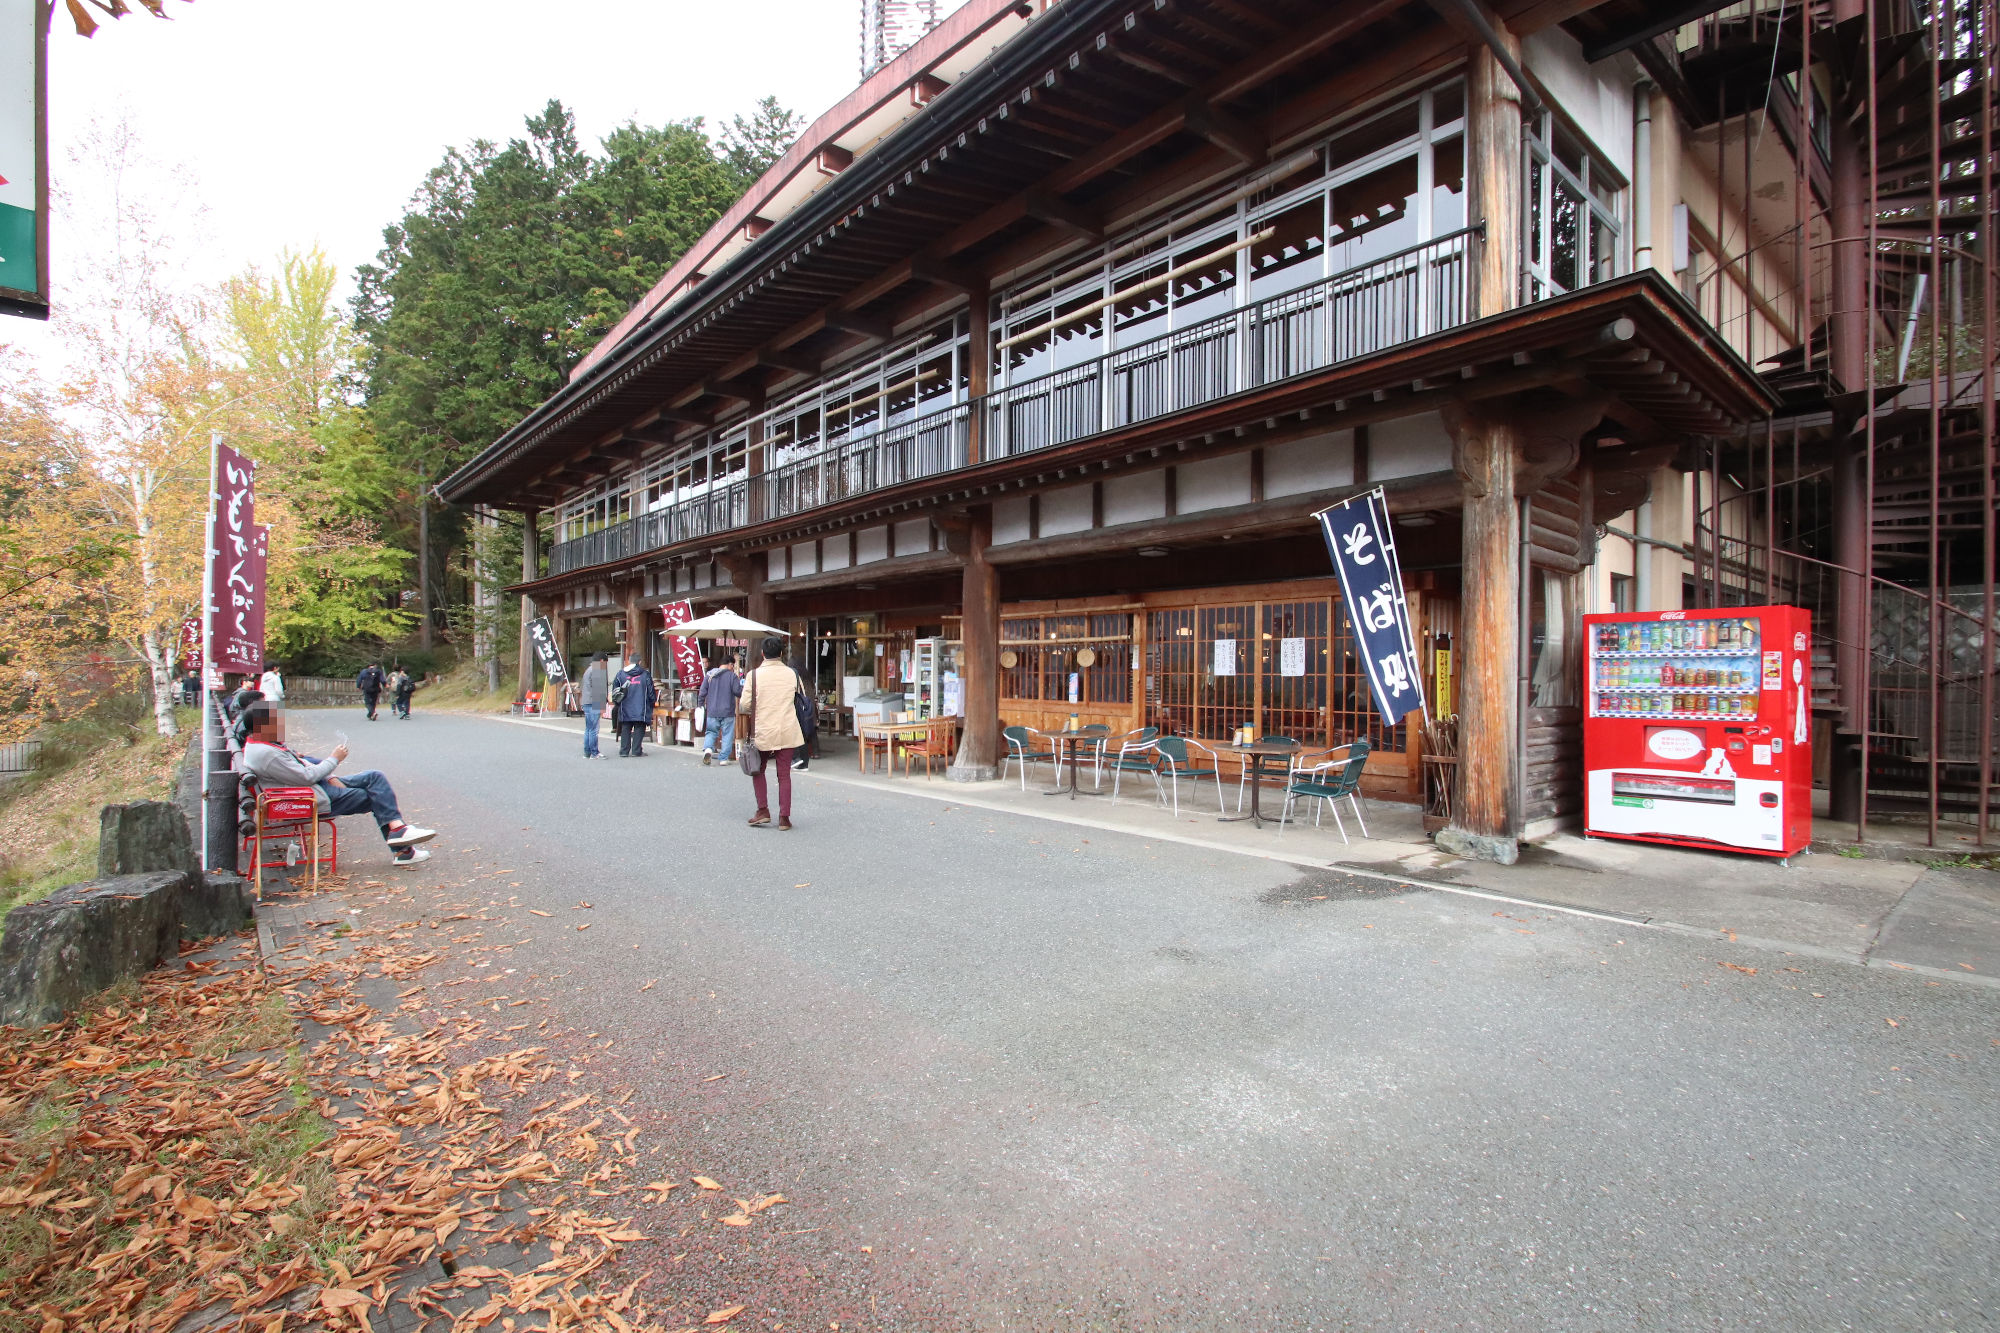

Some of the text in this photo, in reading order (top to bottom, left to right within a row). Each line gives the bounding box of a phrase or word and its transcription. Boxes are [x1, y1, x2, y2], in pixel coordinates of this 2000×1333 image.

[226, 461, 254, 635] いもでんがく
[1343, 523, 1409, 698] そば処
